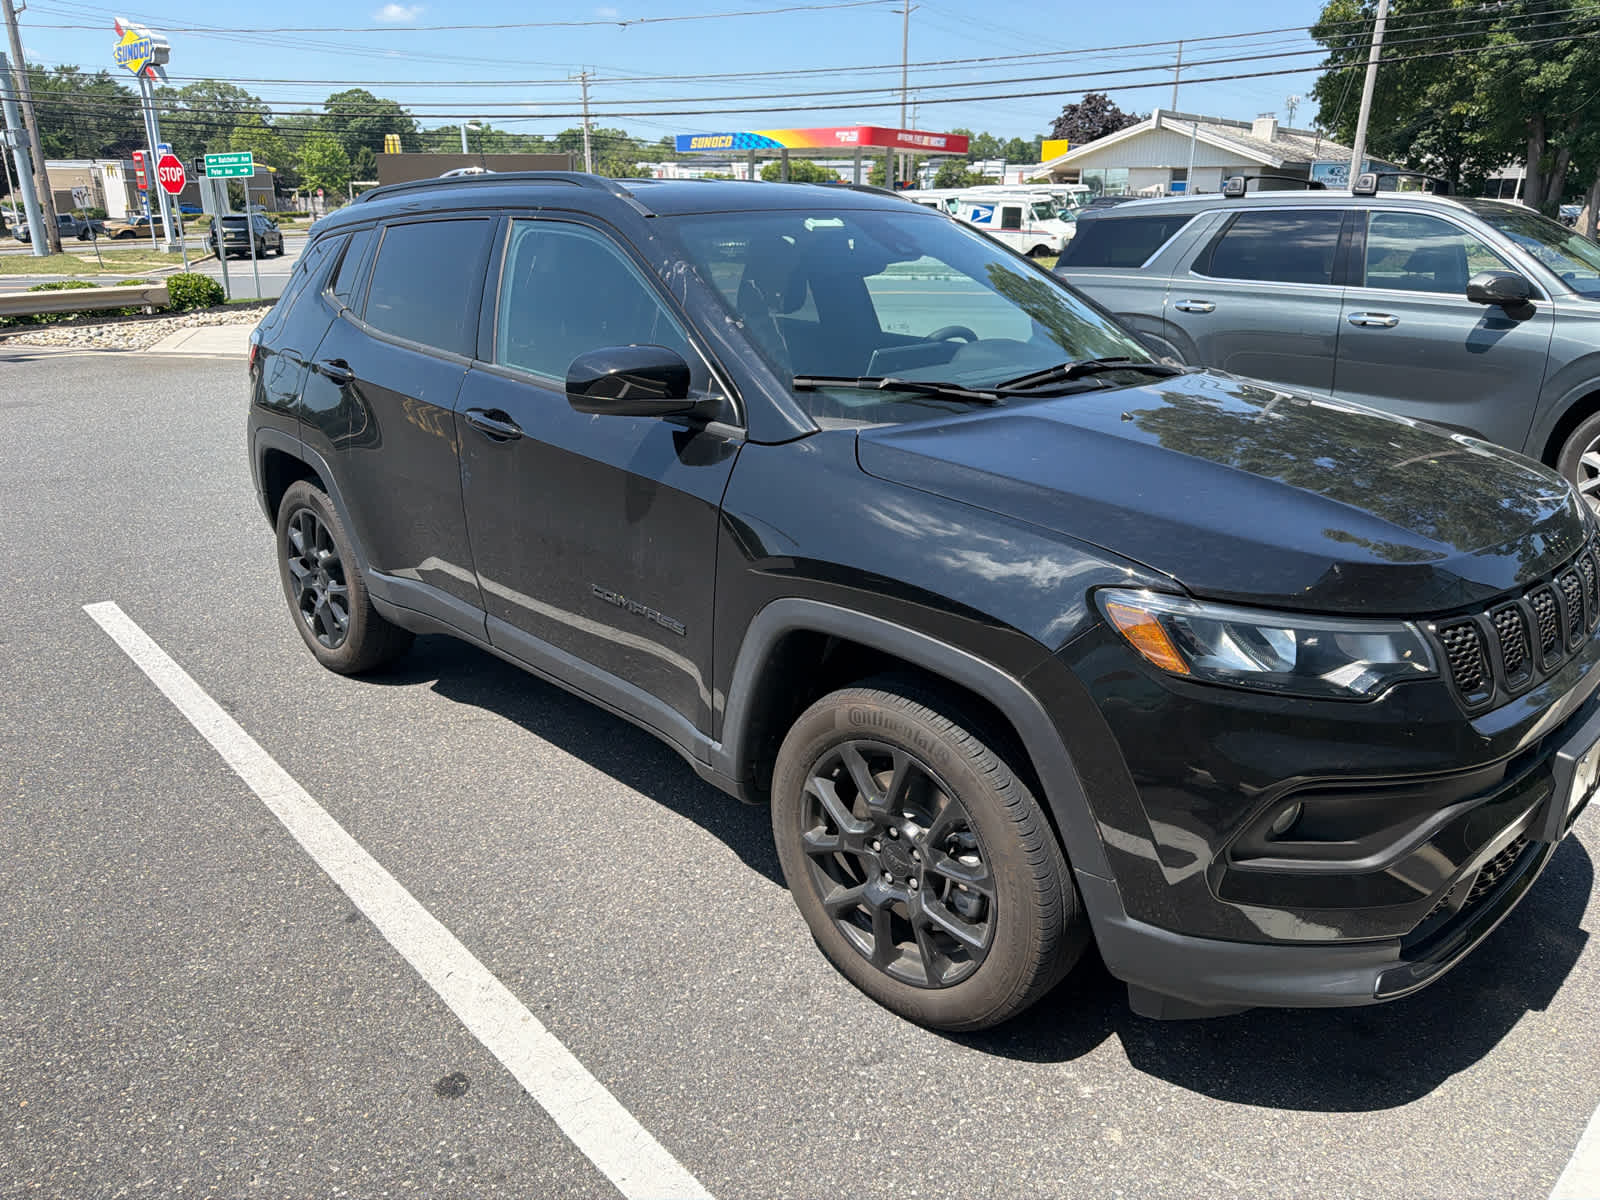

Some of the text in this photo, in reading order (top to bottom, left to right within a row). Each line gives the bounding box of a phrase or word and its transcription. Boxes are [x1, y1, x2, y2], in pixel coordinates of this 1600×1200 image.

[117, 40, 149, 63] SUNOCO
[690, 135, 733, 149] SUNOCO
[159, 167, 183, 182] STOP
